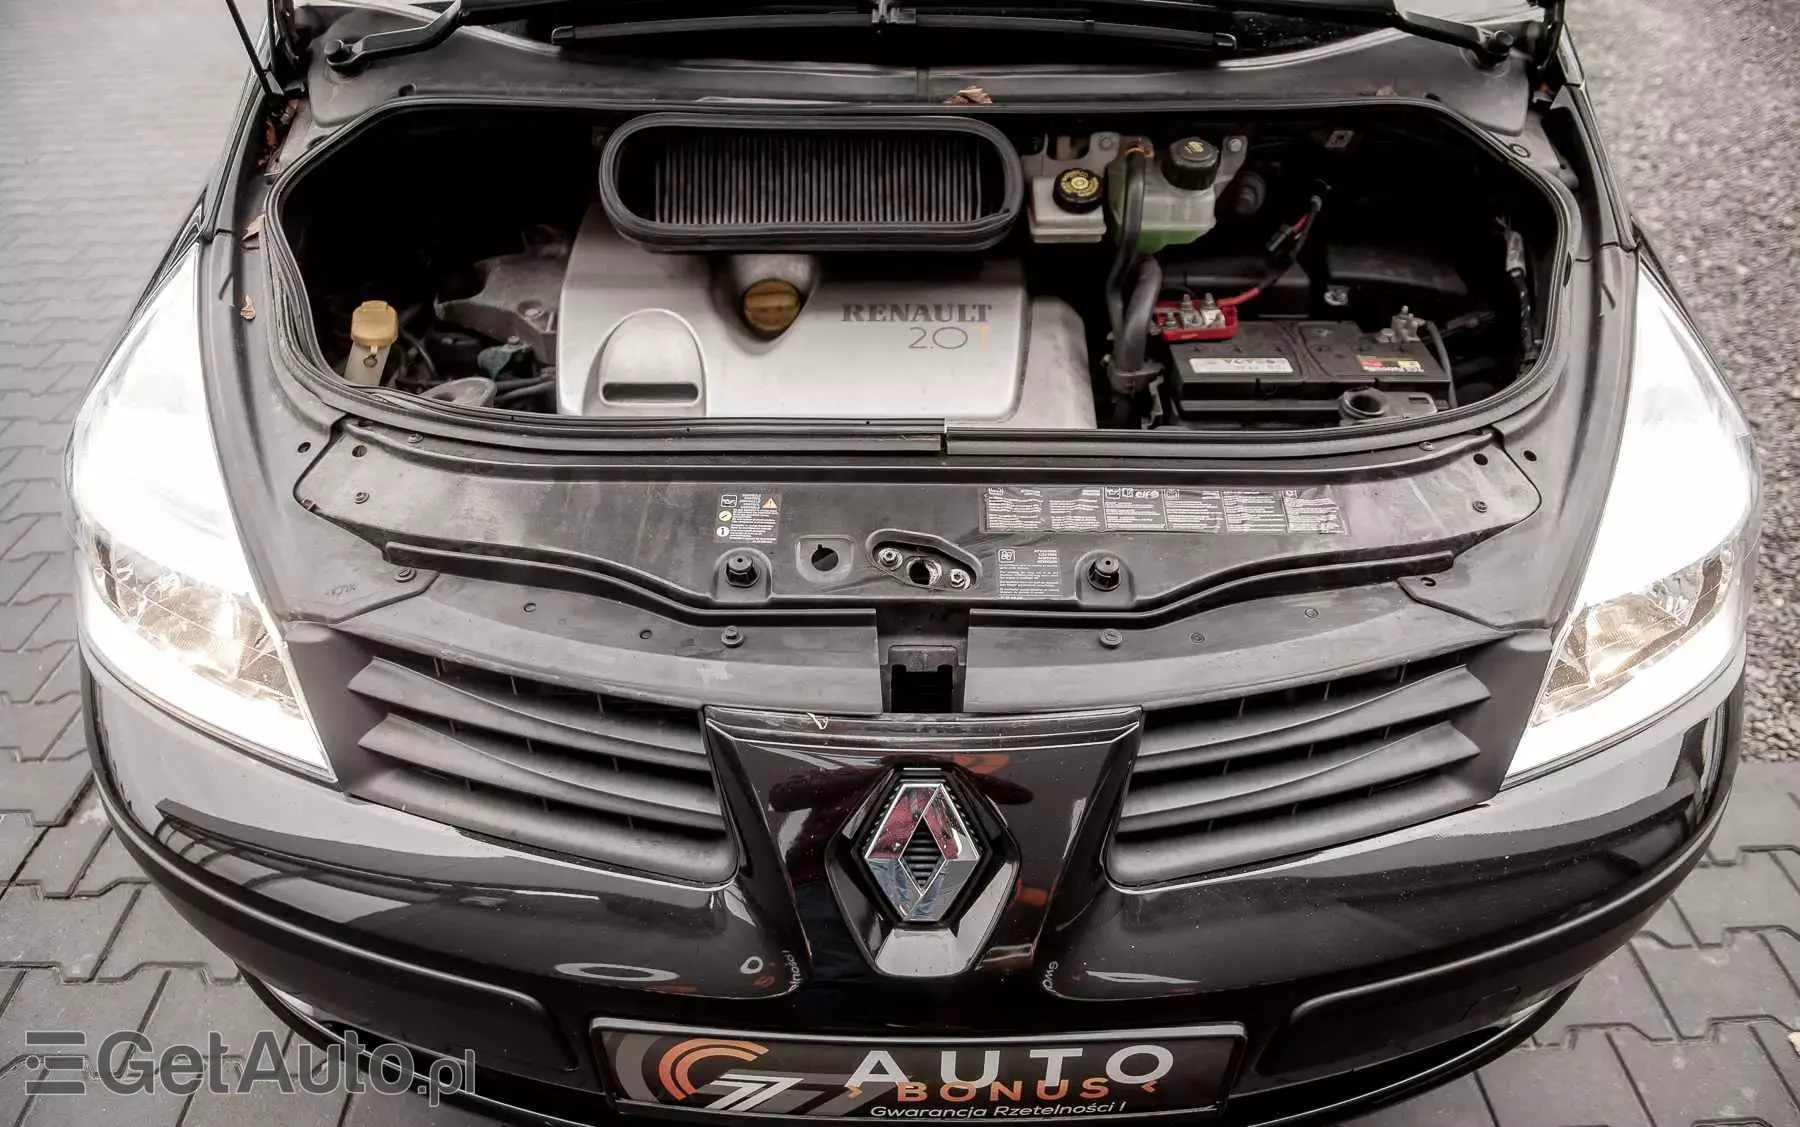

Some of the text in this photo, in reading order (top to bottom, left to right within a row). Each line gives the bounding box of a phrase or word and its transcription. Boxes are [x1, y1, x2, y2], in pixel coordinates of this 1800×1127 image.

[841, 303, 992, 323] RENAULT
[845, 1045, 1174, 1089] AUTO
[897, 1077, 1109, 1102] BONUS
[870, 1106, 987, 1118] Gwarancja
[993, 1101, 1115, 1116] Rzetelności
